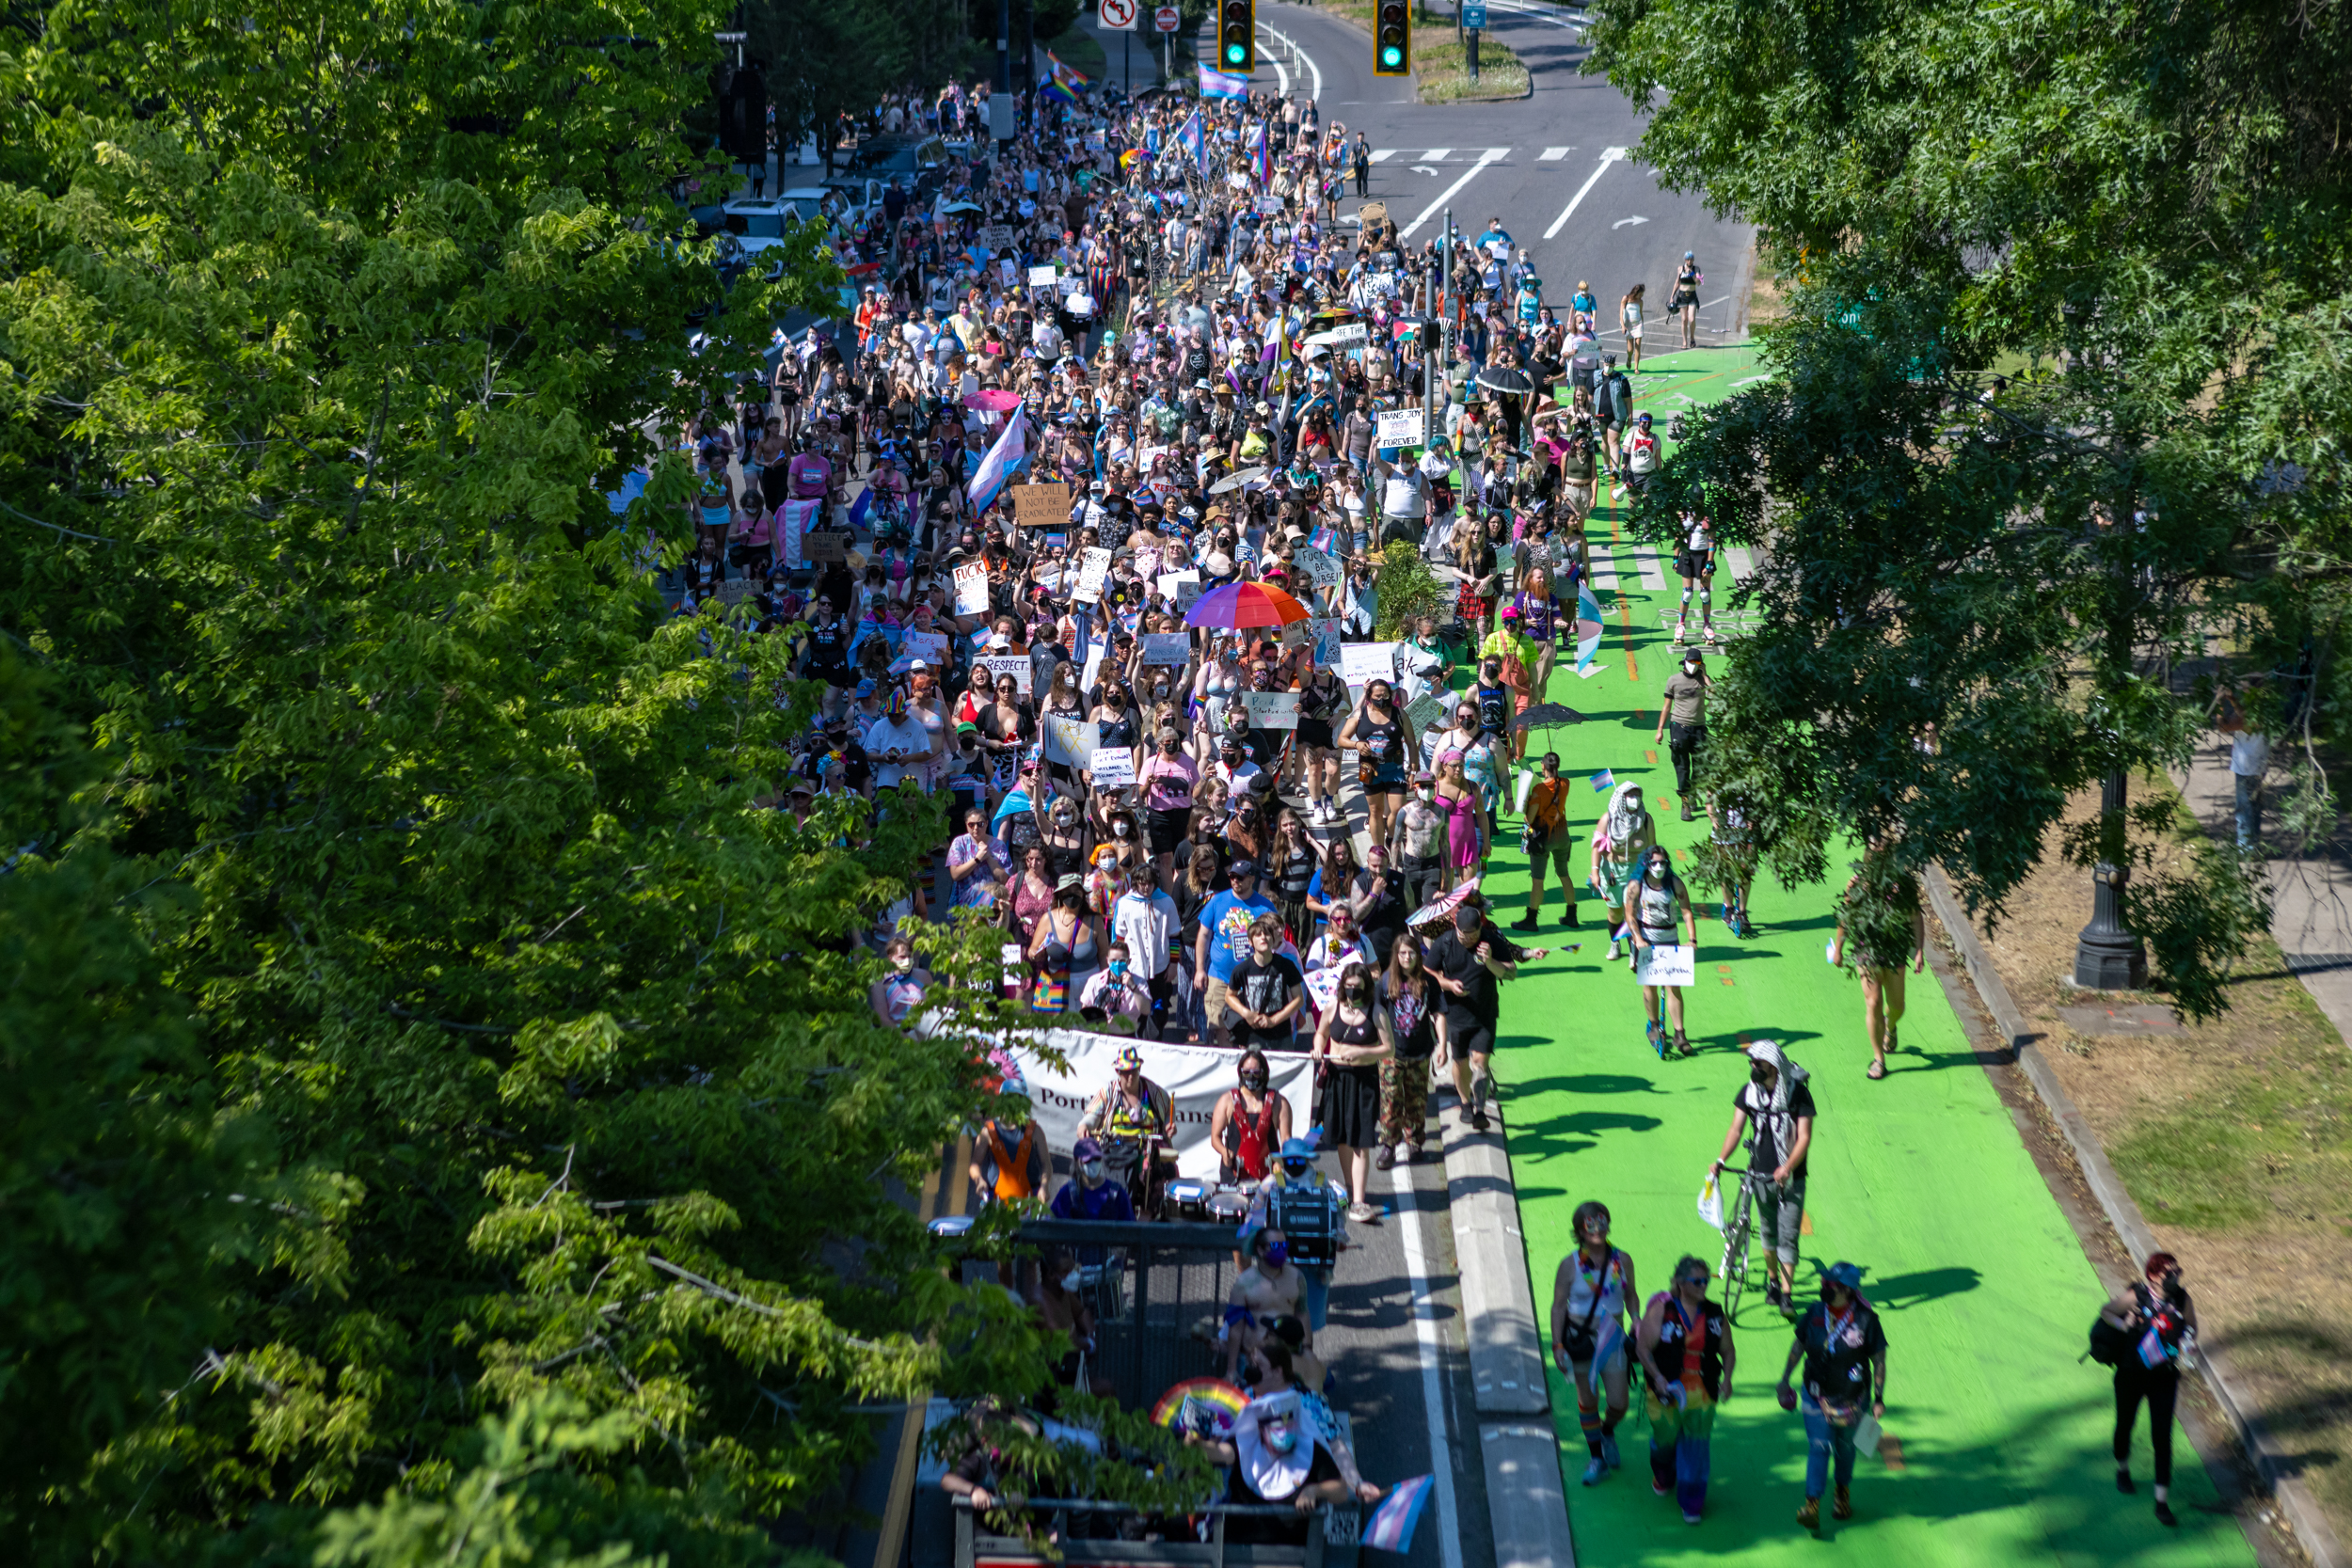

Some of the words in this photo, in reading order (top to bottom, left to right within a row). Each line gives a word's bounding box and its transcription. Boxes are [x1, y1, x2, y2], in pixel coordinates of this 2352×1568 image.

[1351, 325, 1364, 335] THE
[1380, 411, 1404, 420] TRANS
[1406, 409, 1422, 418] JOY
[1383, 436, 1417, 447] FOREVER
[1021, 487, 1037, 497] WE
[1041, 485, 1064, 496] WILL
[1153, 483, 1181, 493] RESIST
[1025, 498, 1044, 508] NOT
[1048, 498, 1060, 506] BE
[1018, 508, 1069, 520] ERADICATED
[804, 533, 841, 542] PROTECT
[1302, 549, 1326, 562] FUCK
[955, 562, 984, 581] FUCK
[1315, 562, 1325, 571] BE
[1311, 572, 1343, 583] OURSELF
[722, 581, 756, 592] BLACK
[987, 659, 1027, 671] RESPECT
[1252, 697, 1281, 707] Pride
[1297, 1215, 1320, 1225] YAMAHA
